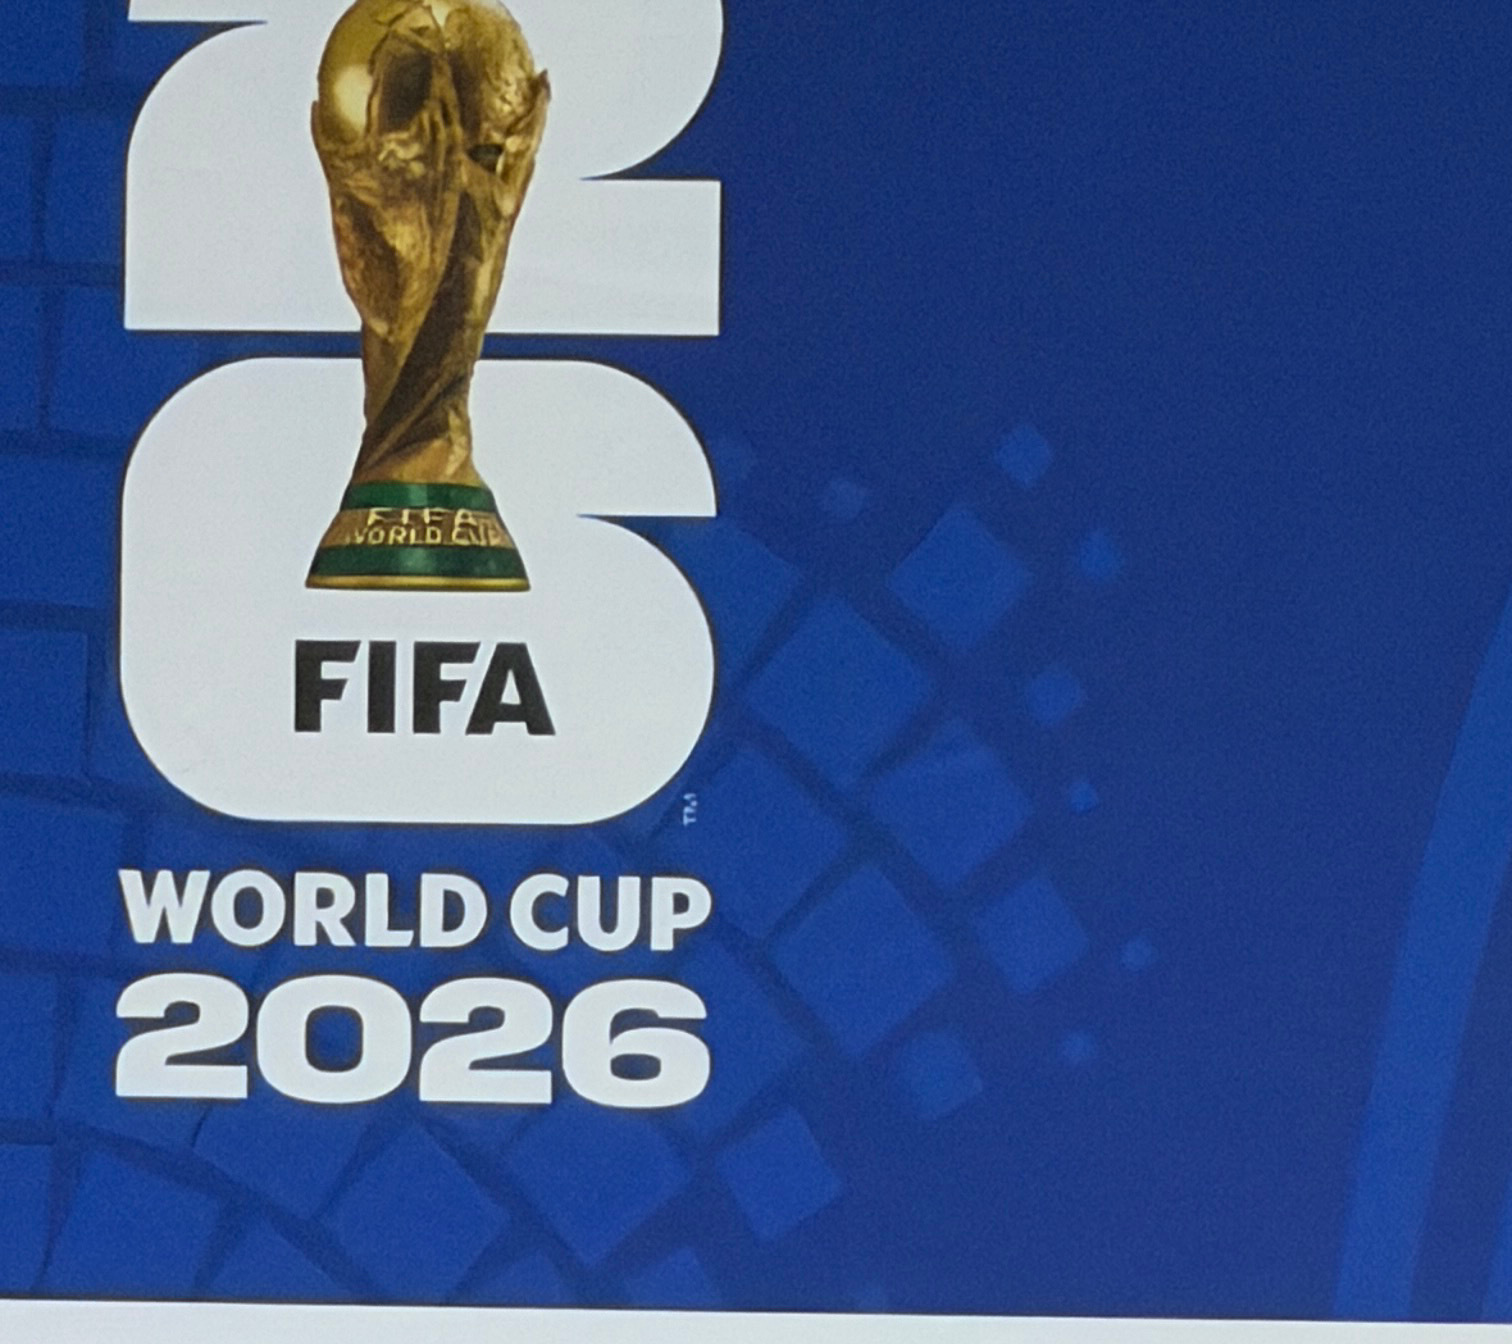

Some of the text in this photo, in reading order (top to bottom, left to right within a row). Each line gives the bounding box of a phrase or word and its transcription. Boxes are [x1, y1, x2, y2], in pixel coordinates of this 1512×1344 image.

[294, 640, 556, 736] FIFA
[118, 869, 712, 952] WORLD CUP
[115, 972, 711, 1108] 2026
